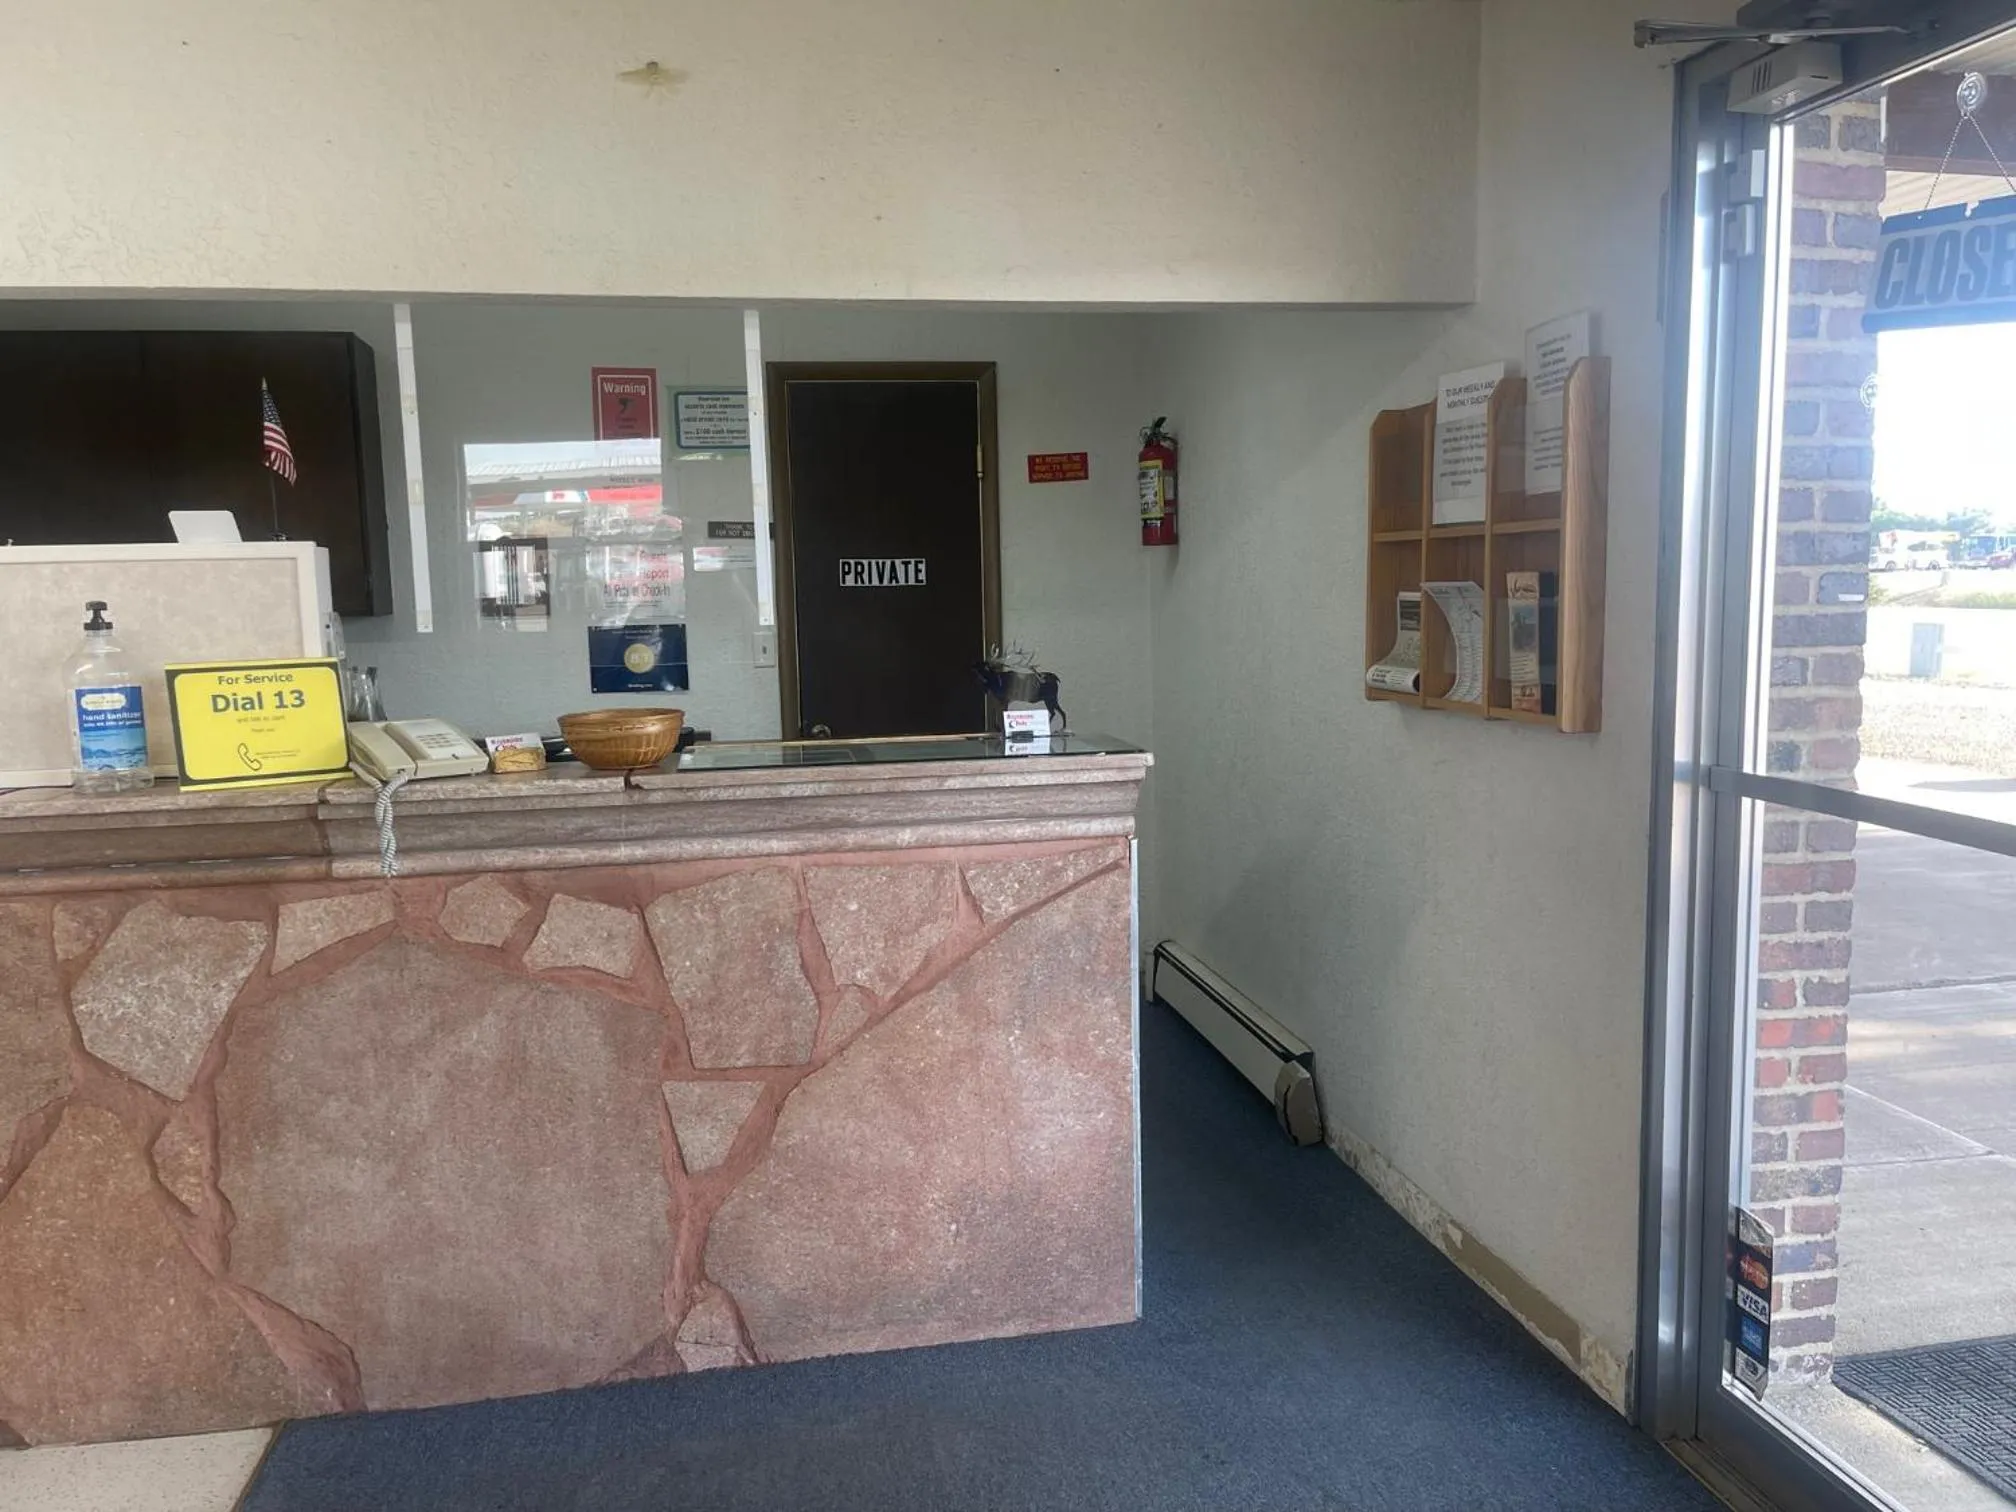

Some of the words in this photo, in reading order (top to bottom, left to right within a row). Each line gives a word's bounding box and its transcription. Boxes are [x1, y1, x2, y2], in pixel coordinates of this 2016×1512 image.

[603, 382, 647, 396] Warning
[841, 560, 925, 585] PRIVATE
[217, 675, 239, 685] For
[244, 672, 293, 684] Service
[211, 691, 264, 713] Dial
[273, 689, 306, 709] 13
[1742, 1291, 1768, 1318] VISA
